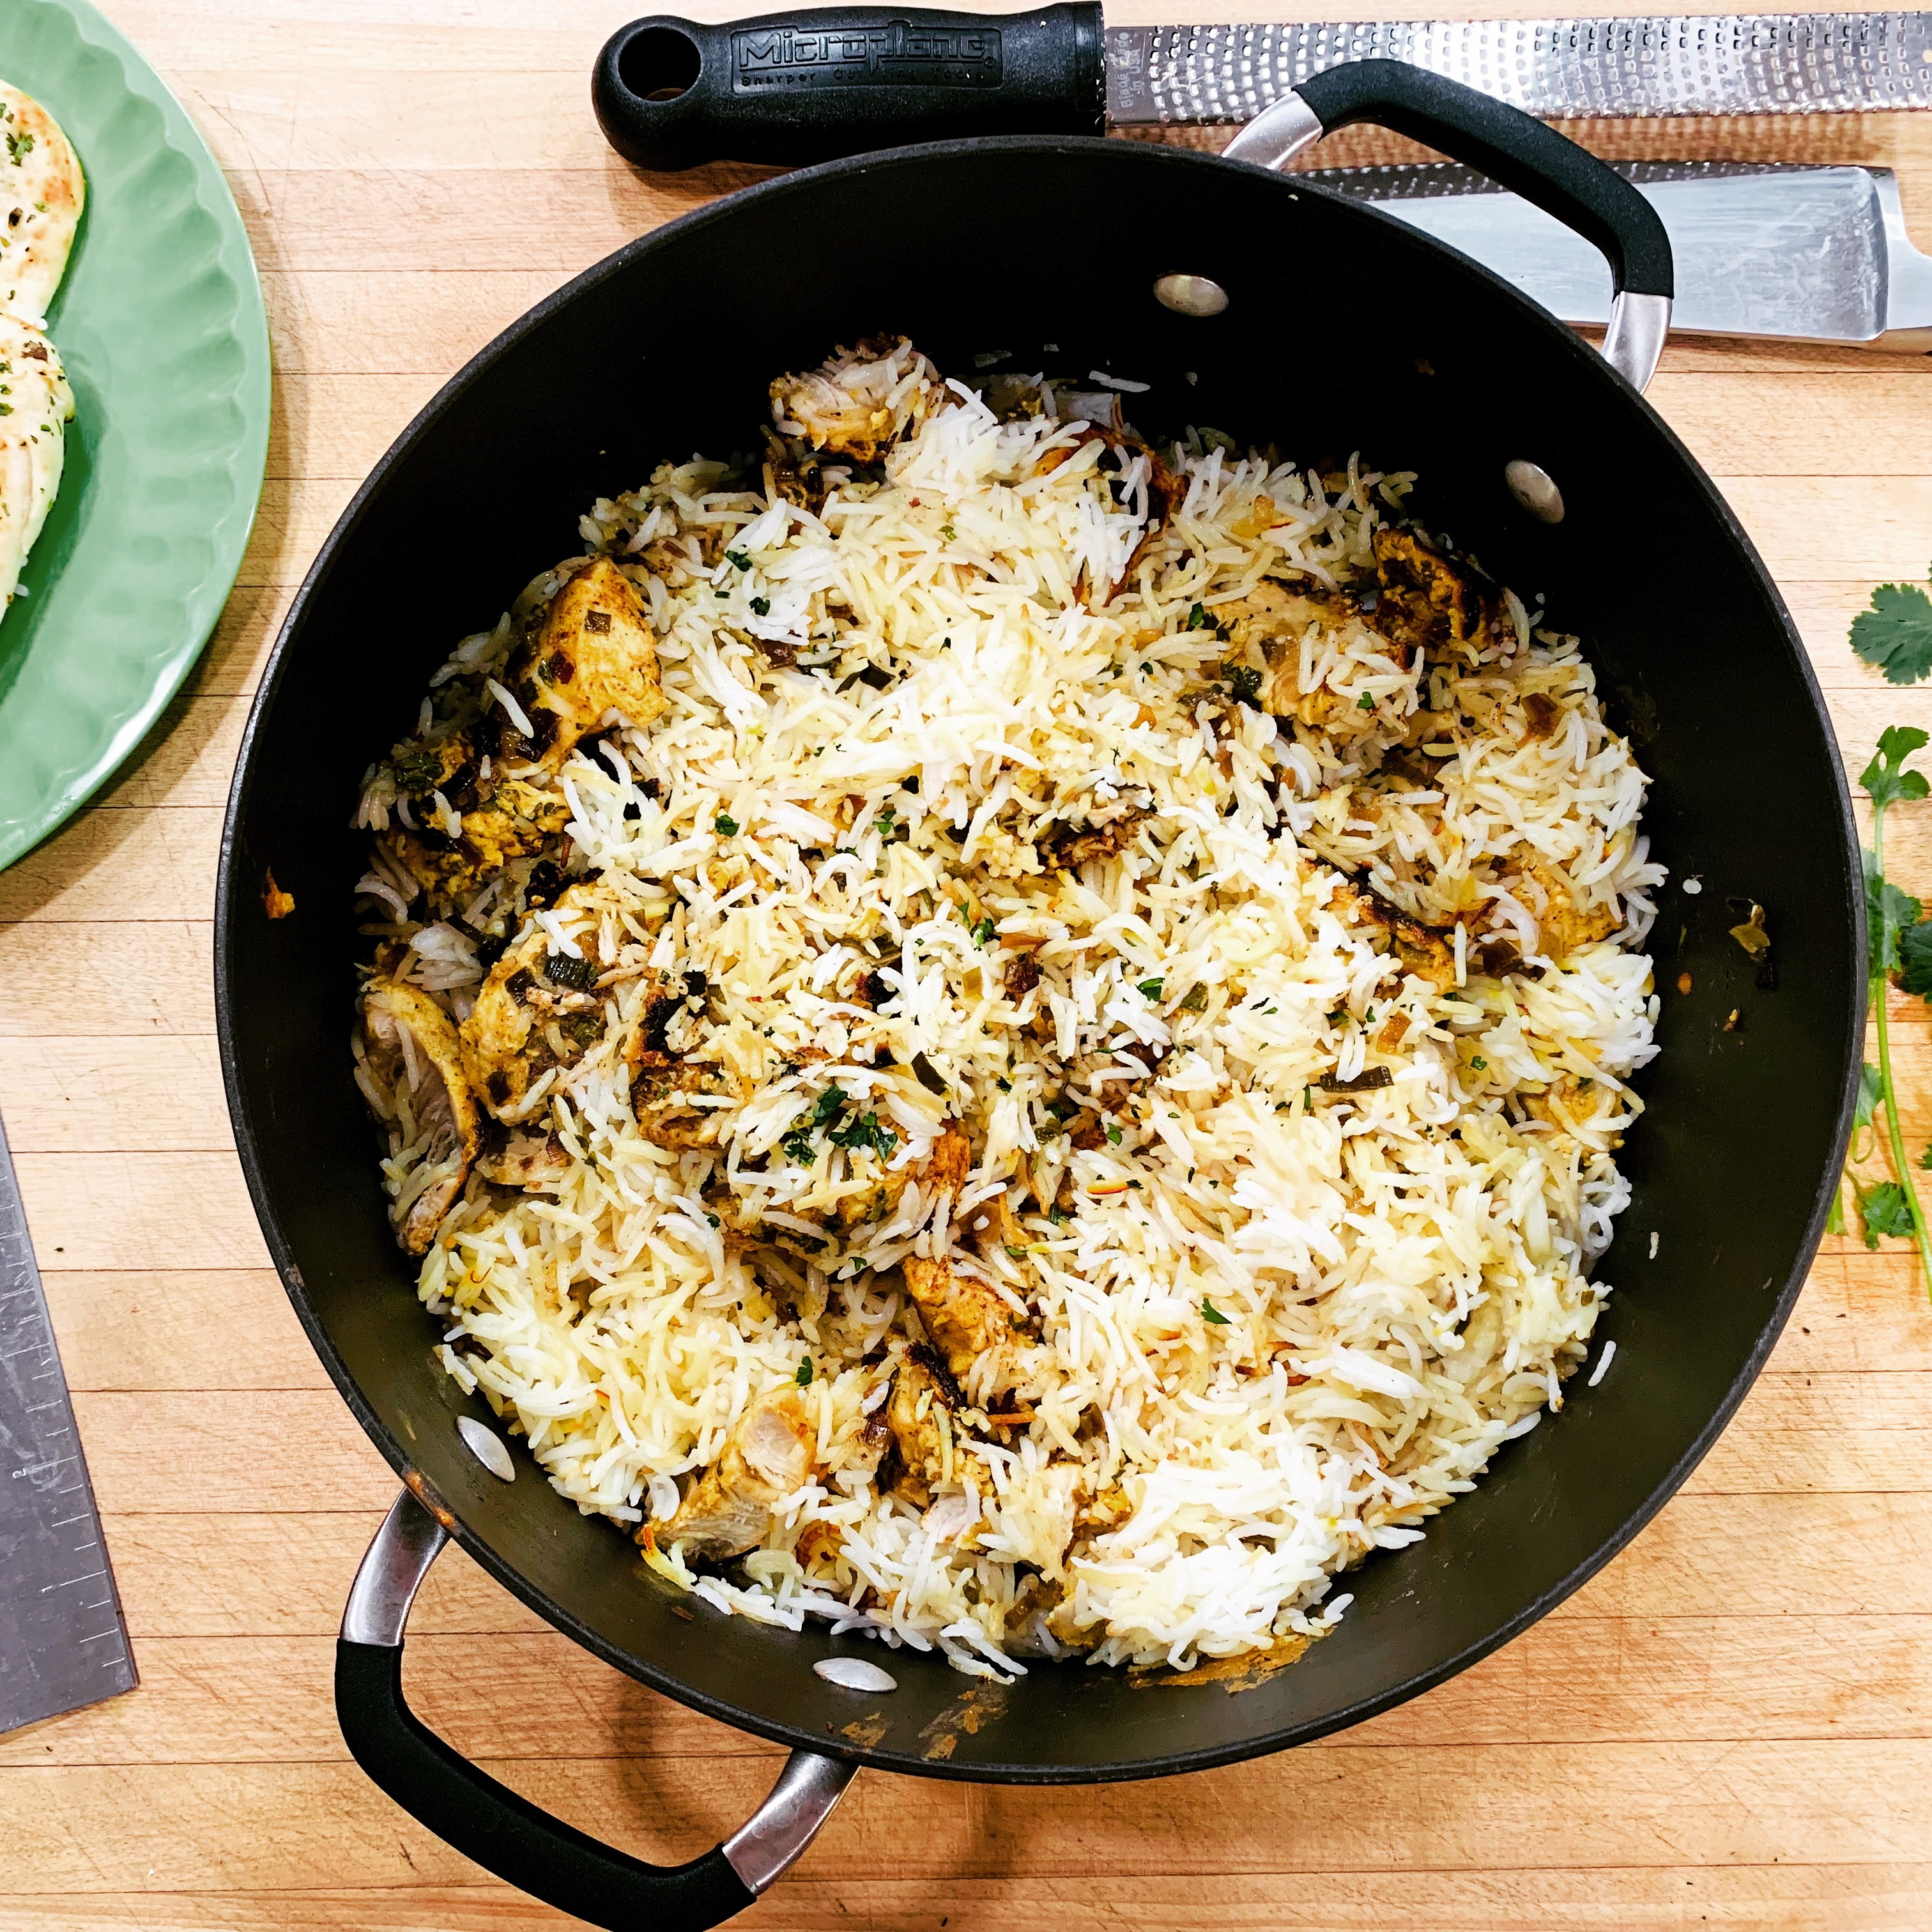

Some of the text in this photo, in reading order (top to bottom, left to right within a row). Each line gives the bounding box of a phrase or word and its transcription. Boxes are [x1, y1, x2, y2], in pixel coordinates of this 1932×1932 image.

[1130, 49, 1140, 73] USA
[742, 72, 816, 86] Sharper
[931, 66, 984, 79] Tools
[1117, 73, 1133, 108] Blade
[12, 1468, 26, 1478] 2
